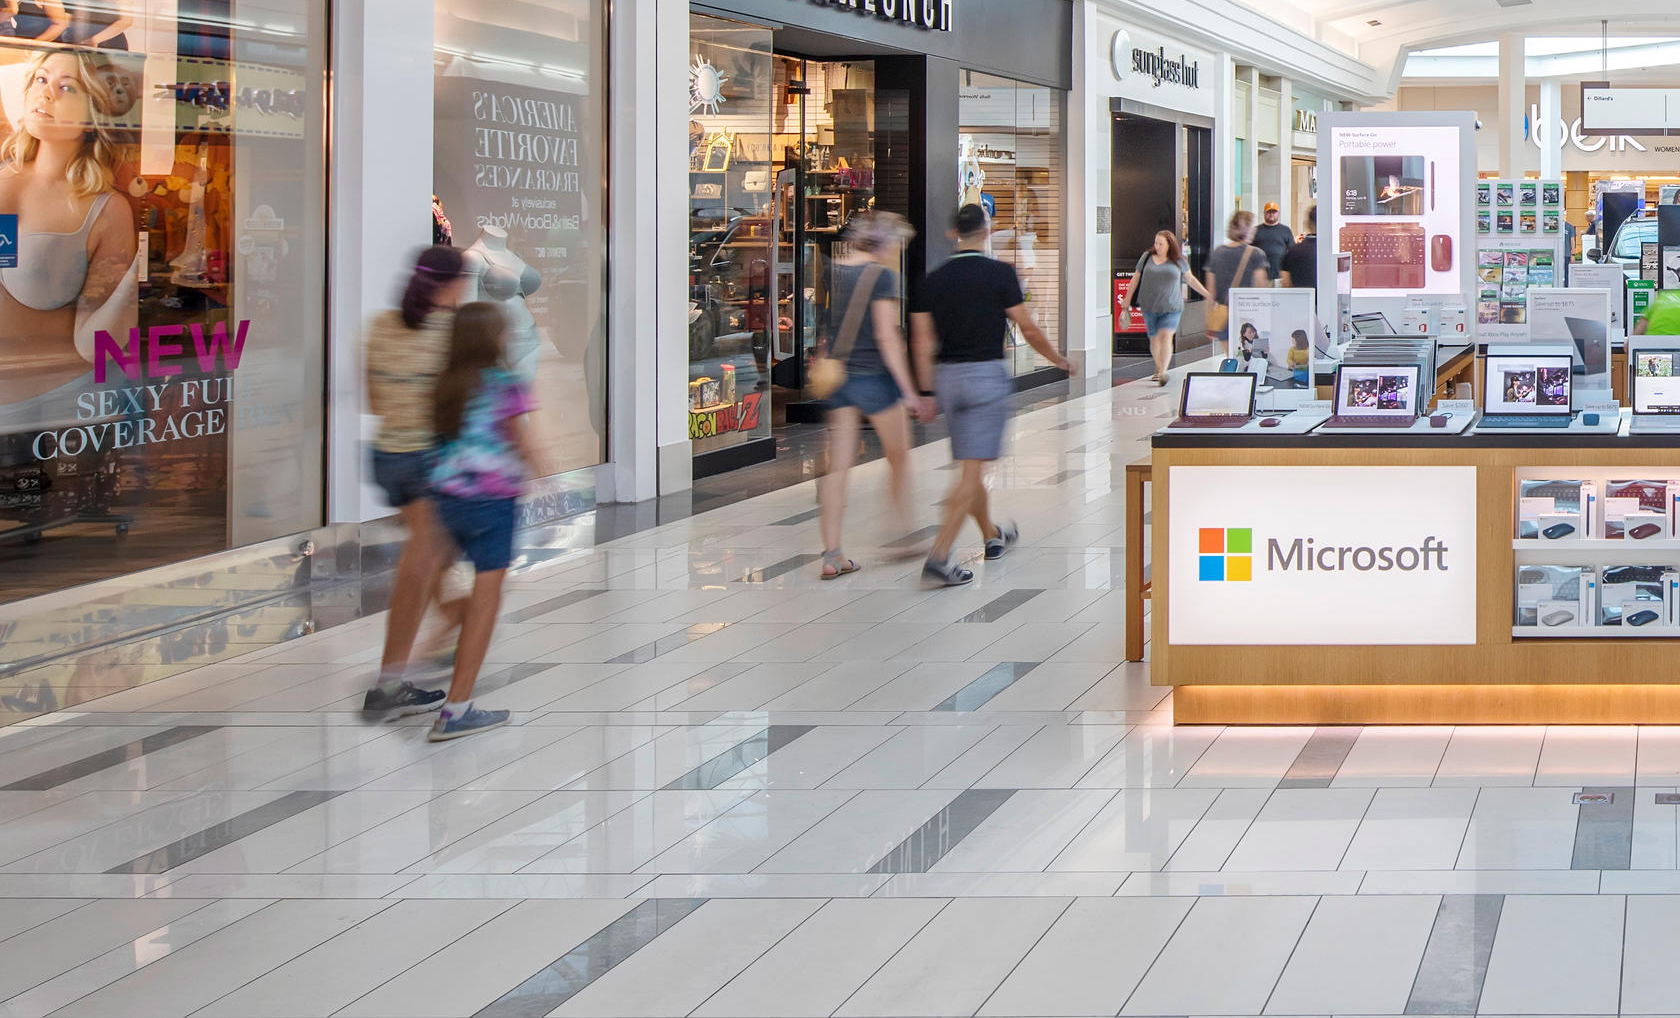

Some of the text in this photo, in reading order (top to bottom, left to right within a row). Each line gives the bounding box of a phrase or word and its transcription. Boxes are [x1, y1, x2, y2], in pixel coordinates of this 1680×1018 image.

[1131, 46, 1200, 89] sunglass hut
[1339, 140, 1397, 150] Portable power
[94, 320, 251, 384] NEW
[77, 381, 169, 421] SEXY
[738, 391, 762, 433] Z
[32, 409, 226, 461] COVERAGE
[1267, 535, 1449, 571] Microsoft
